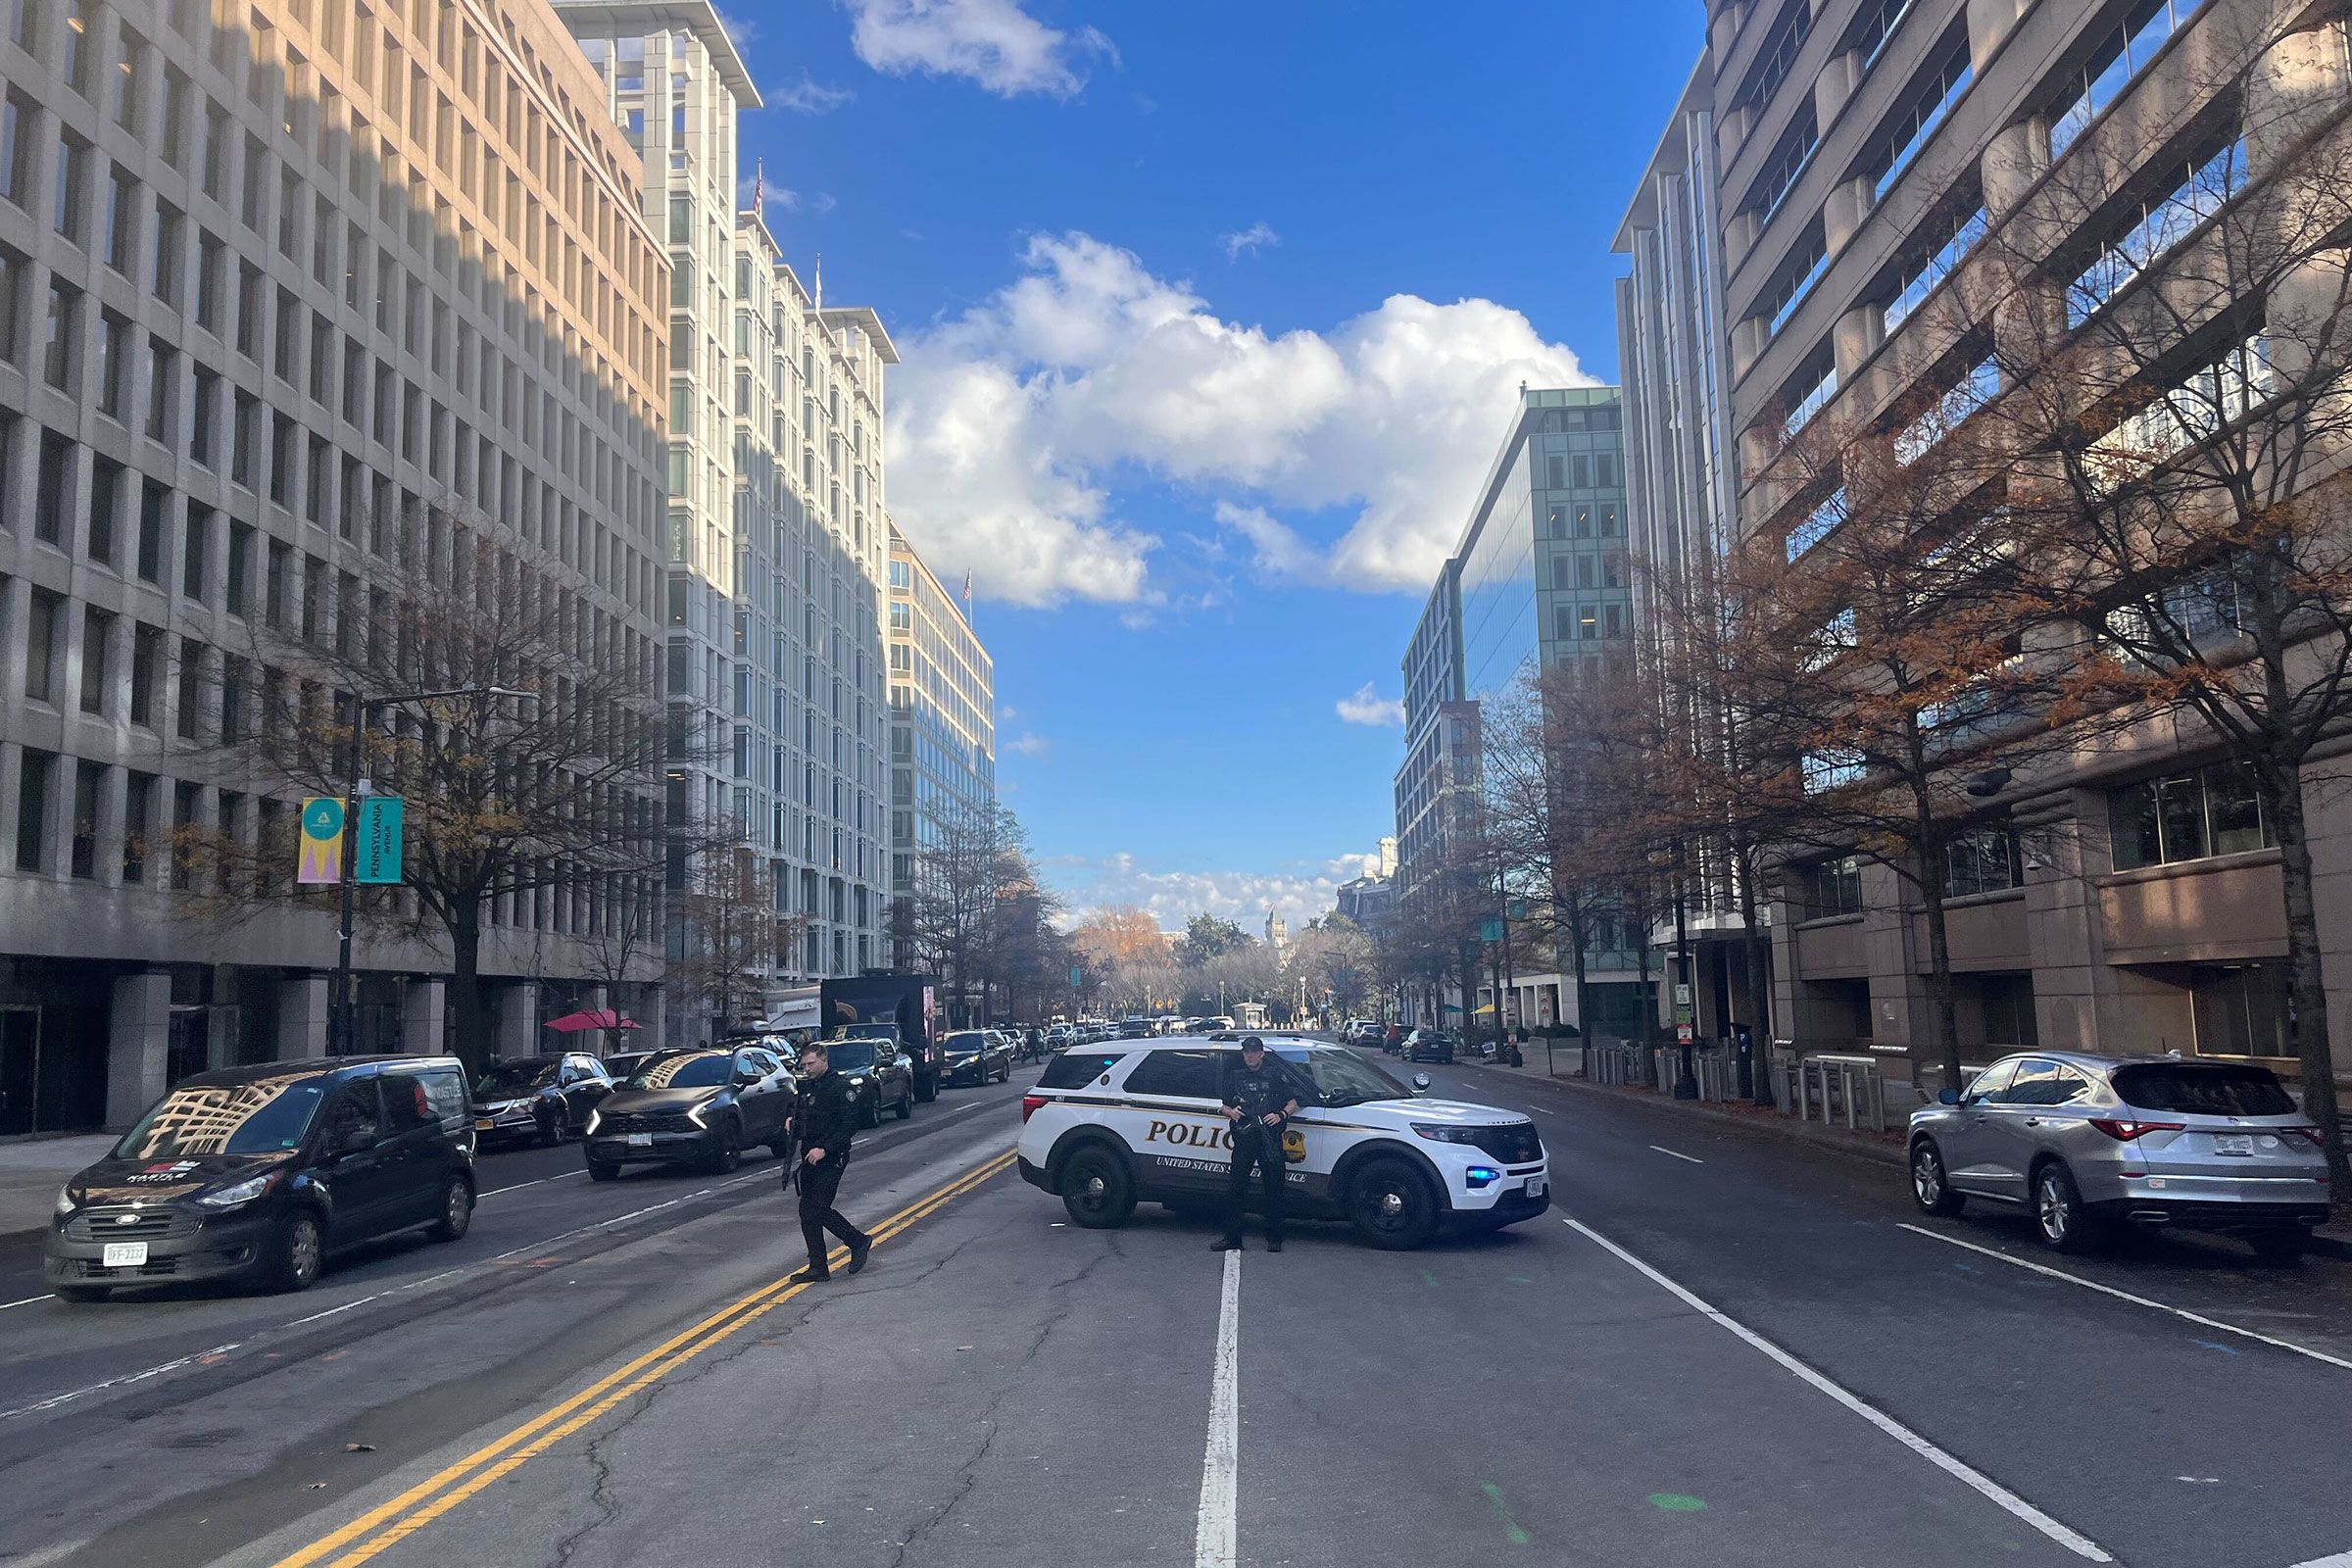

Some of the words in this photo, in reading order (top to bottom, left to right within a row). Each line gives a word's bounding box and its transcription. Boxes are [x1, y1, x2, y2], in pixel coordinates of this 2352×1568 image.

[370, 804, 382, 878] PENNSYLVANIA
[1156, 1156, 1191, 1169] UNITED
[1192, 1160, 1225, 1173] STATES
